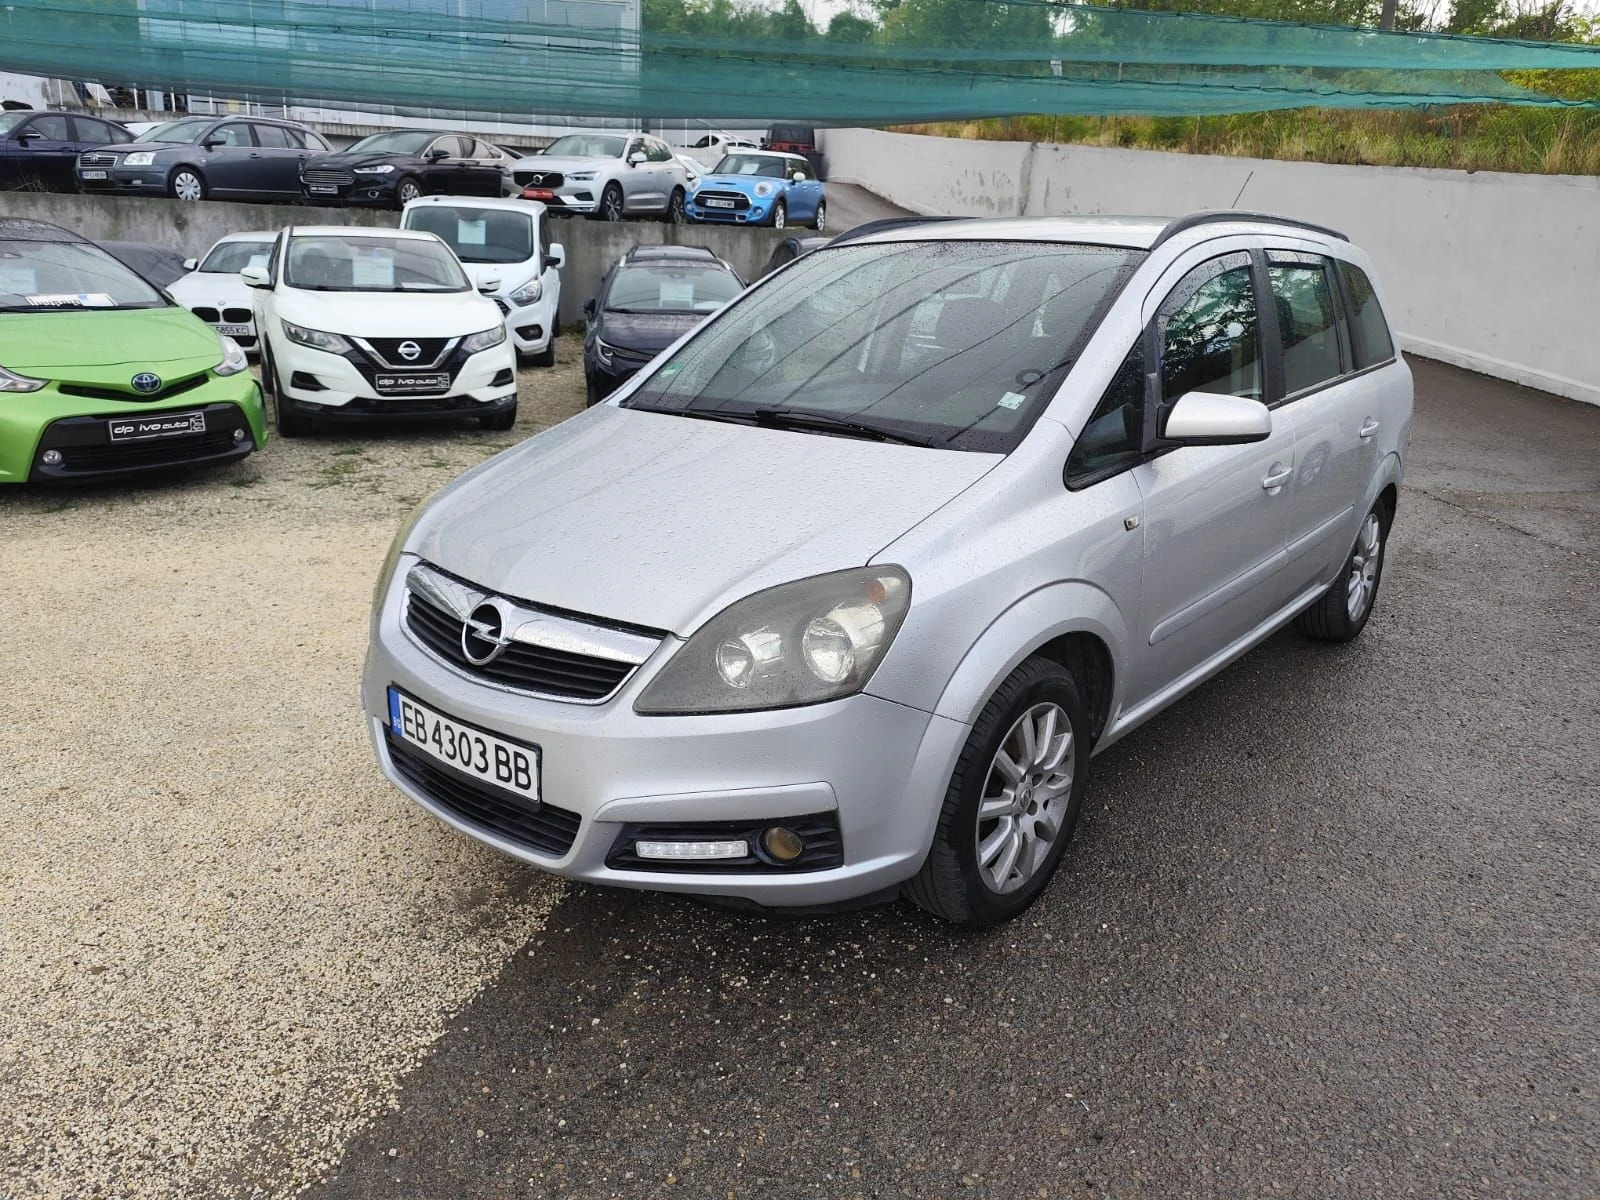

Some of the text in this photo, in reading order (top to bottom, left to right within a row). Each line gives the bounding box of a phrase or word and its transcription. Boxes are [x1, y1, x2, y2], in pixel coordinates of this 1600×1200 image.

[379, 378, 394, 386] dp
[114, 425, 134, 435] dp
[162, 421, 189, 430] auto
[402, 701, 531, 790] EB 4303 BB
